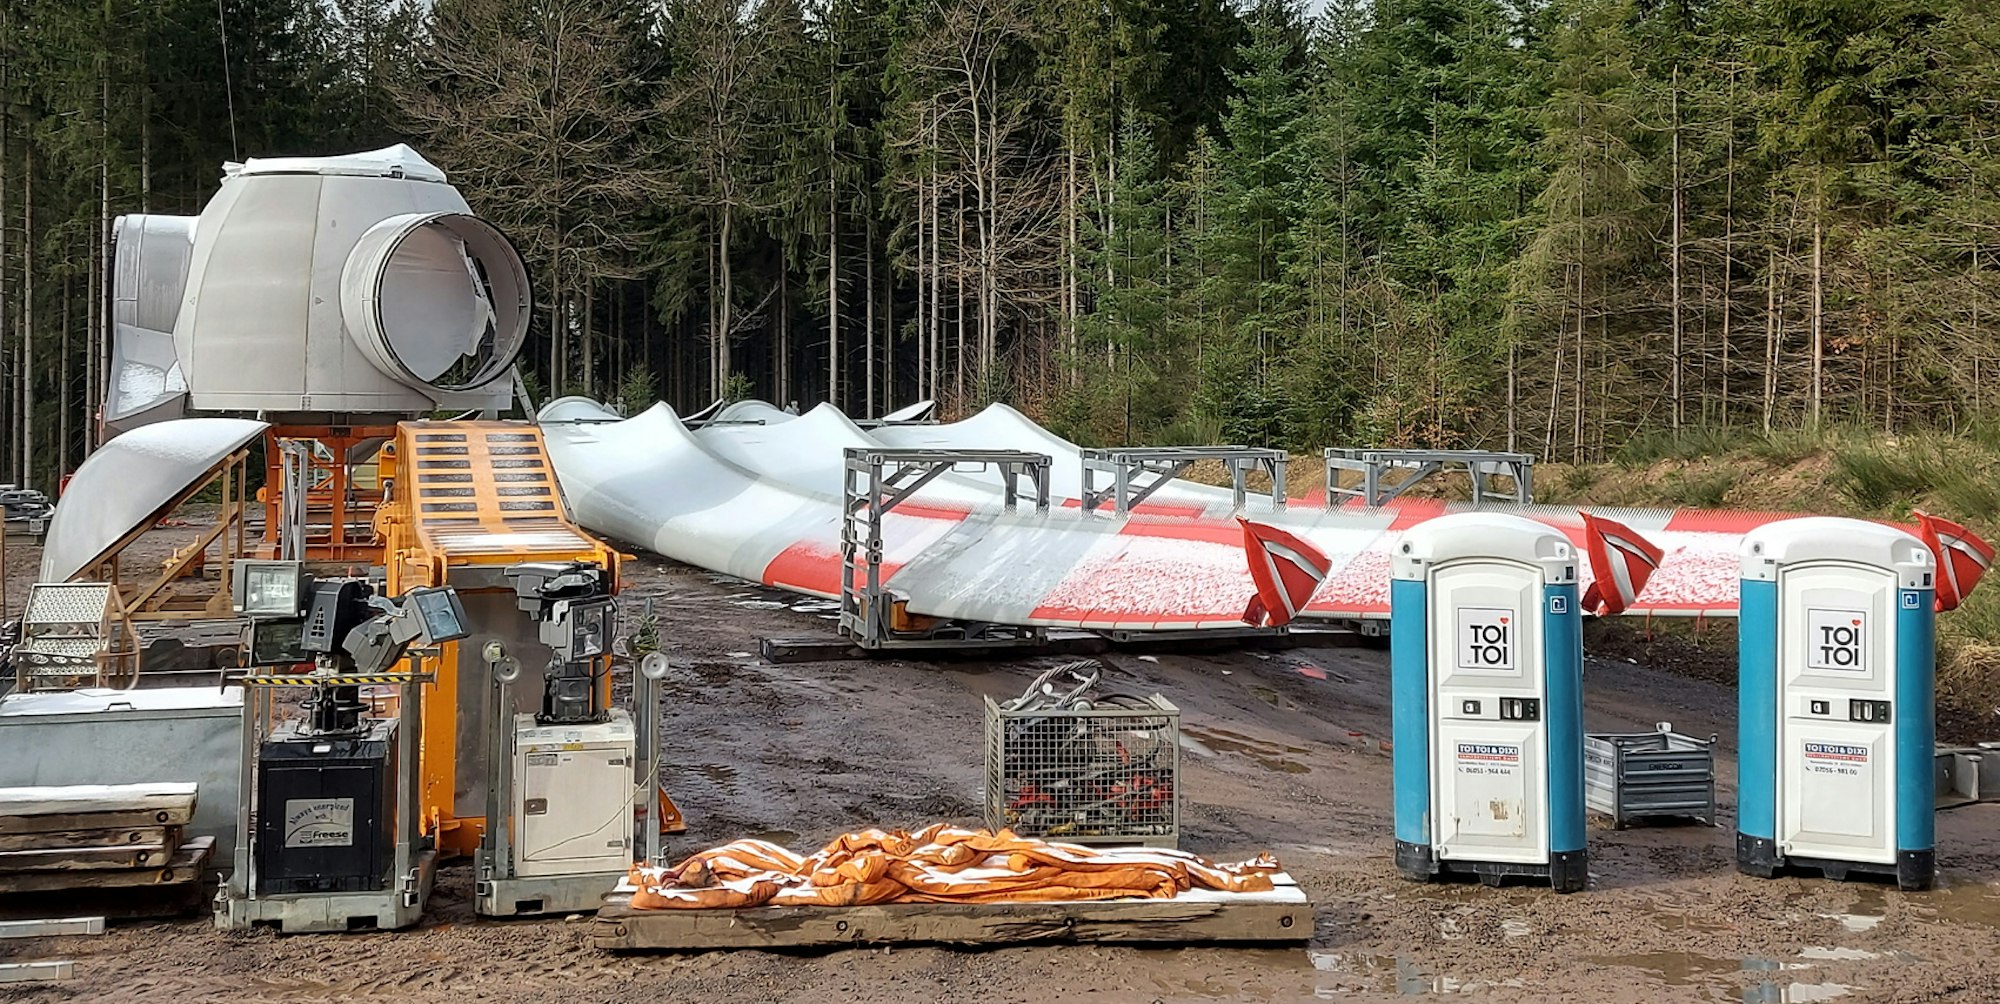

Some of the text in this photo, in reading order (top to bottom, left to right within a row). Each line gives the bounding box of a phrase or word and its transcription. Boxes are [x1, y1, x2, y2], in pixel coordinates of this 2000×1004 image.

[1470, 624, 1508, 645] TOI
[1820, 626, 1859, 646] TOI
[1470, 645, 1508, 665] TOI
[1820, 646, 1859, 666] TOI
[1459, 745, 1475, 753] TOI
[1475, 746, 1491, 754] TOI
[1498, 747, 1518, 755] DIXI
[1806, 744, 1866, 756] TOI TOI & DIXI
[1648, 762, 1683, 771] ENERCON
[312, 830, 349, 838] Freese
